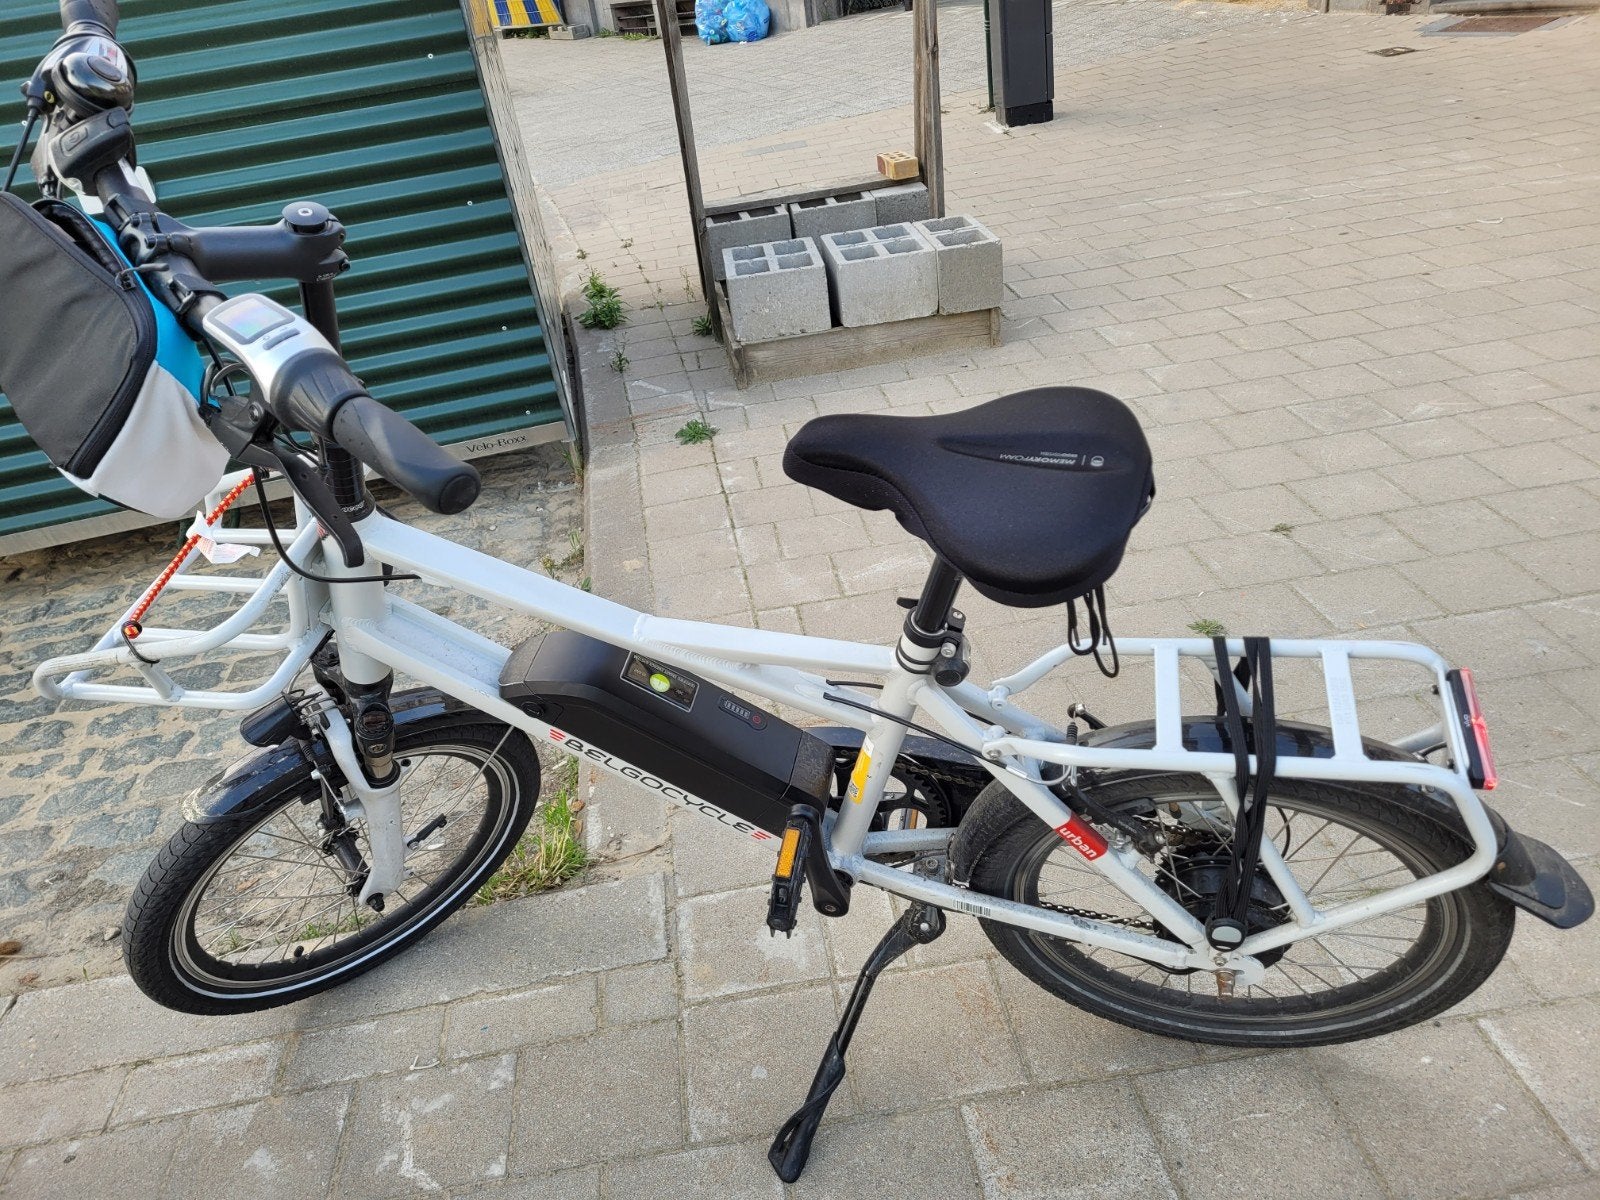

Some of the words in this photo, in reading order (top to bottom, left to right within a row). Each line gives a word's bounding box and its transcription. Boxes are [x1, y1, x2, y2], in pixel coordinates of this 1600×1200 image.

[466, 435, 526, 453] Velo-Boxx
[1000, 453, 1076, 465] MEMORYFOAM
[564, 738, 755, 834] BELGOCYCLE
[1059, 827, 1097, 858] urban
